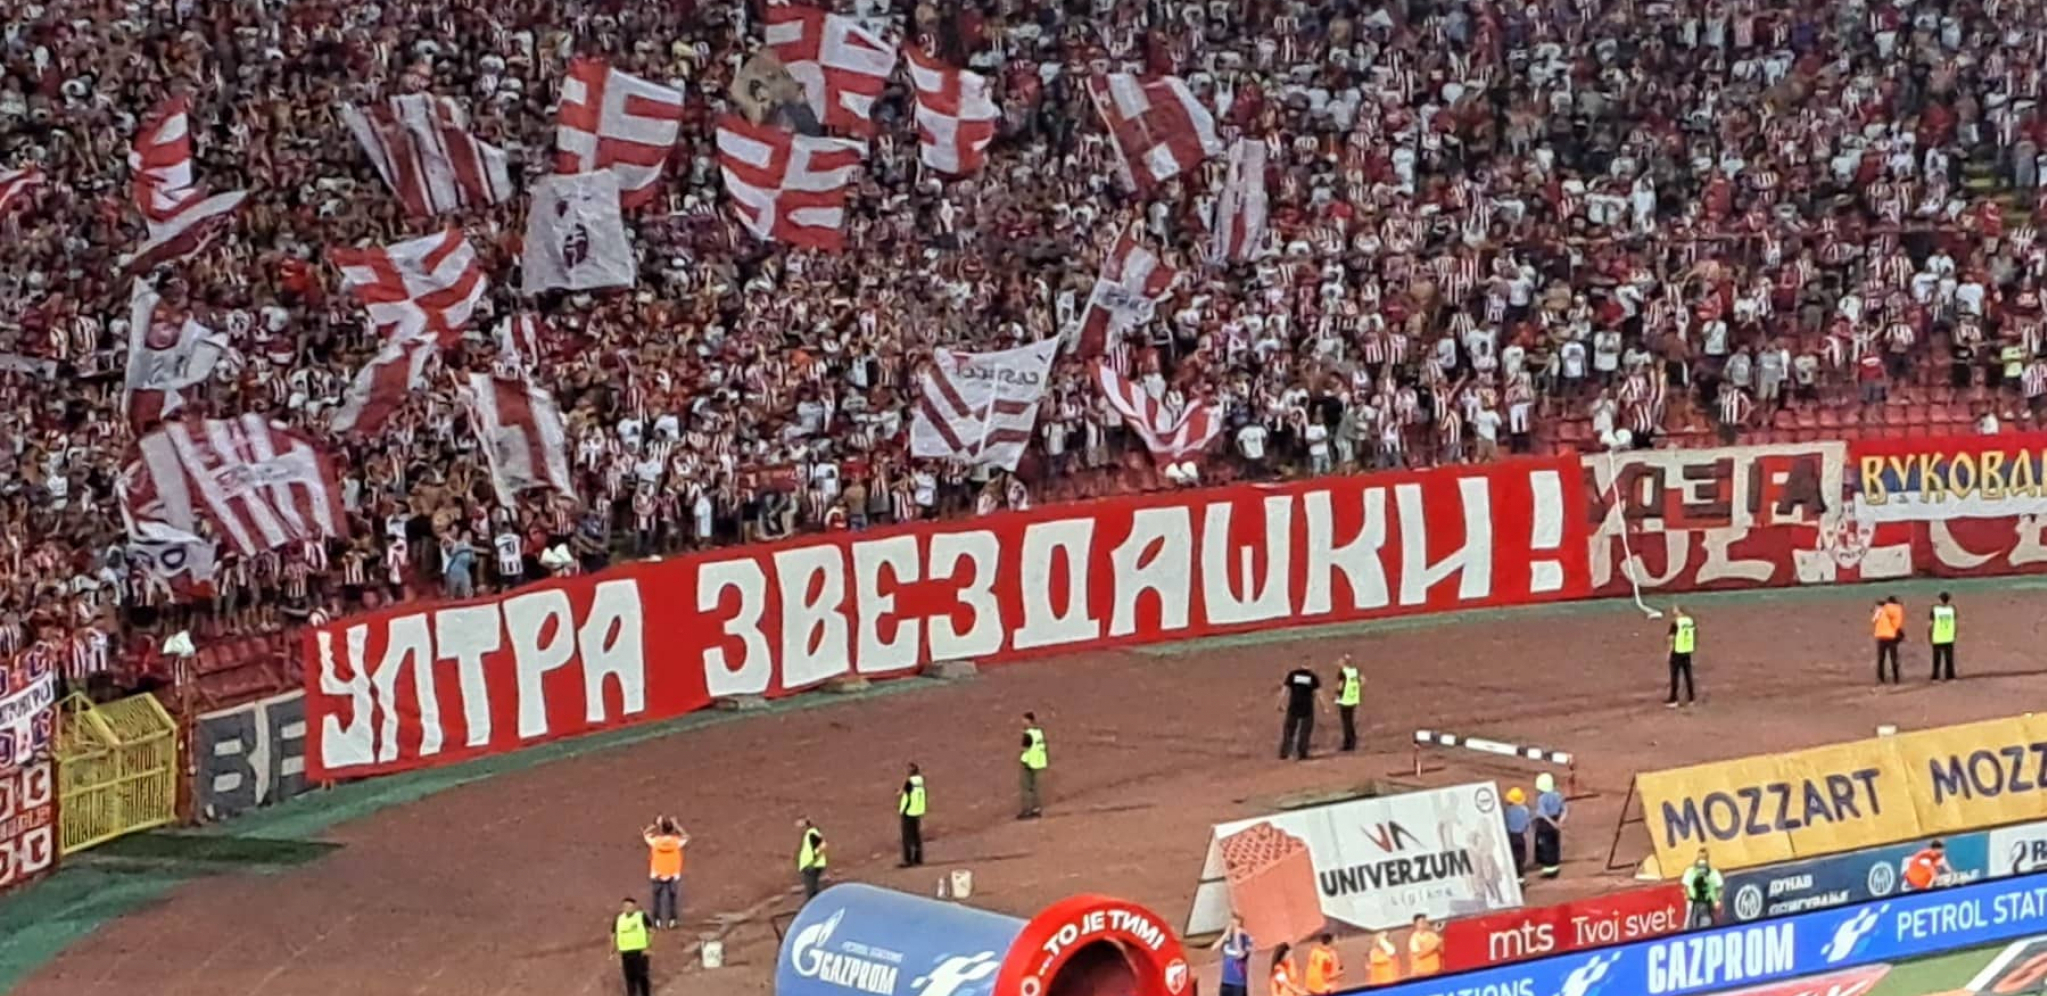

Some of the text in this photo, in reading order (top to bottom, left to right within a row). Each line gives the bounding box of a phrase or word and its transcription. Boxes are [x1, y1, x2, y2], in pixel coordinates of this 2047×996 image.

[317, 578, 646, 769] УЛТРА
[1662, 768, 1880, 848] MOZZART
[1319, 849, 1474, 897] UNIVERZUM
[1489, 903, 1677, 961] mts Tvoj svet
[1897, 899, 1988, 942] PETROL
[820, 953, 899, 996] GAZPROM
[1648, 923, 1794, 994] GAZPROM
